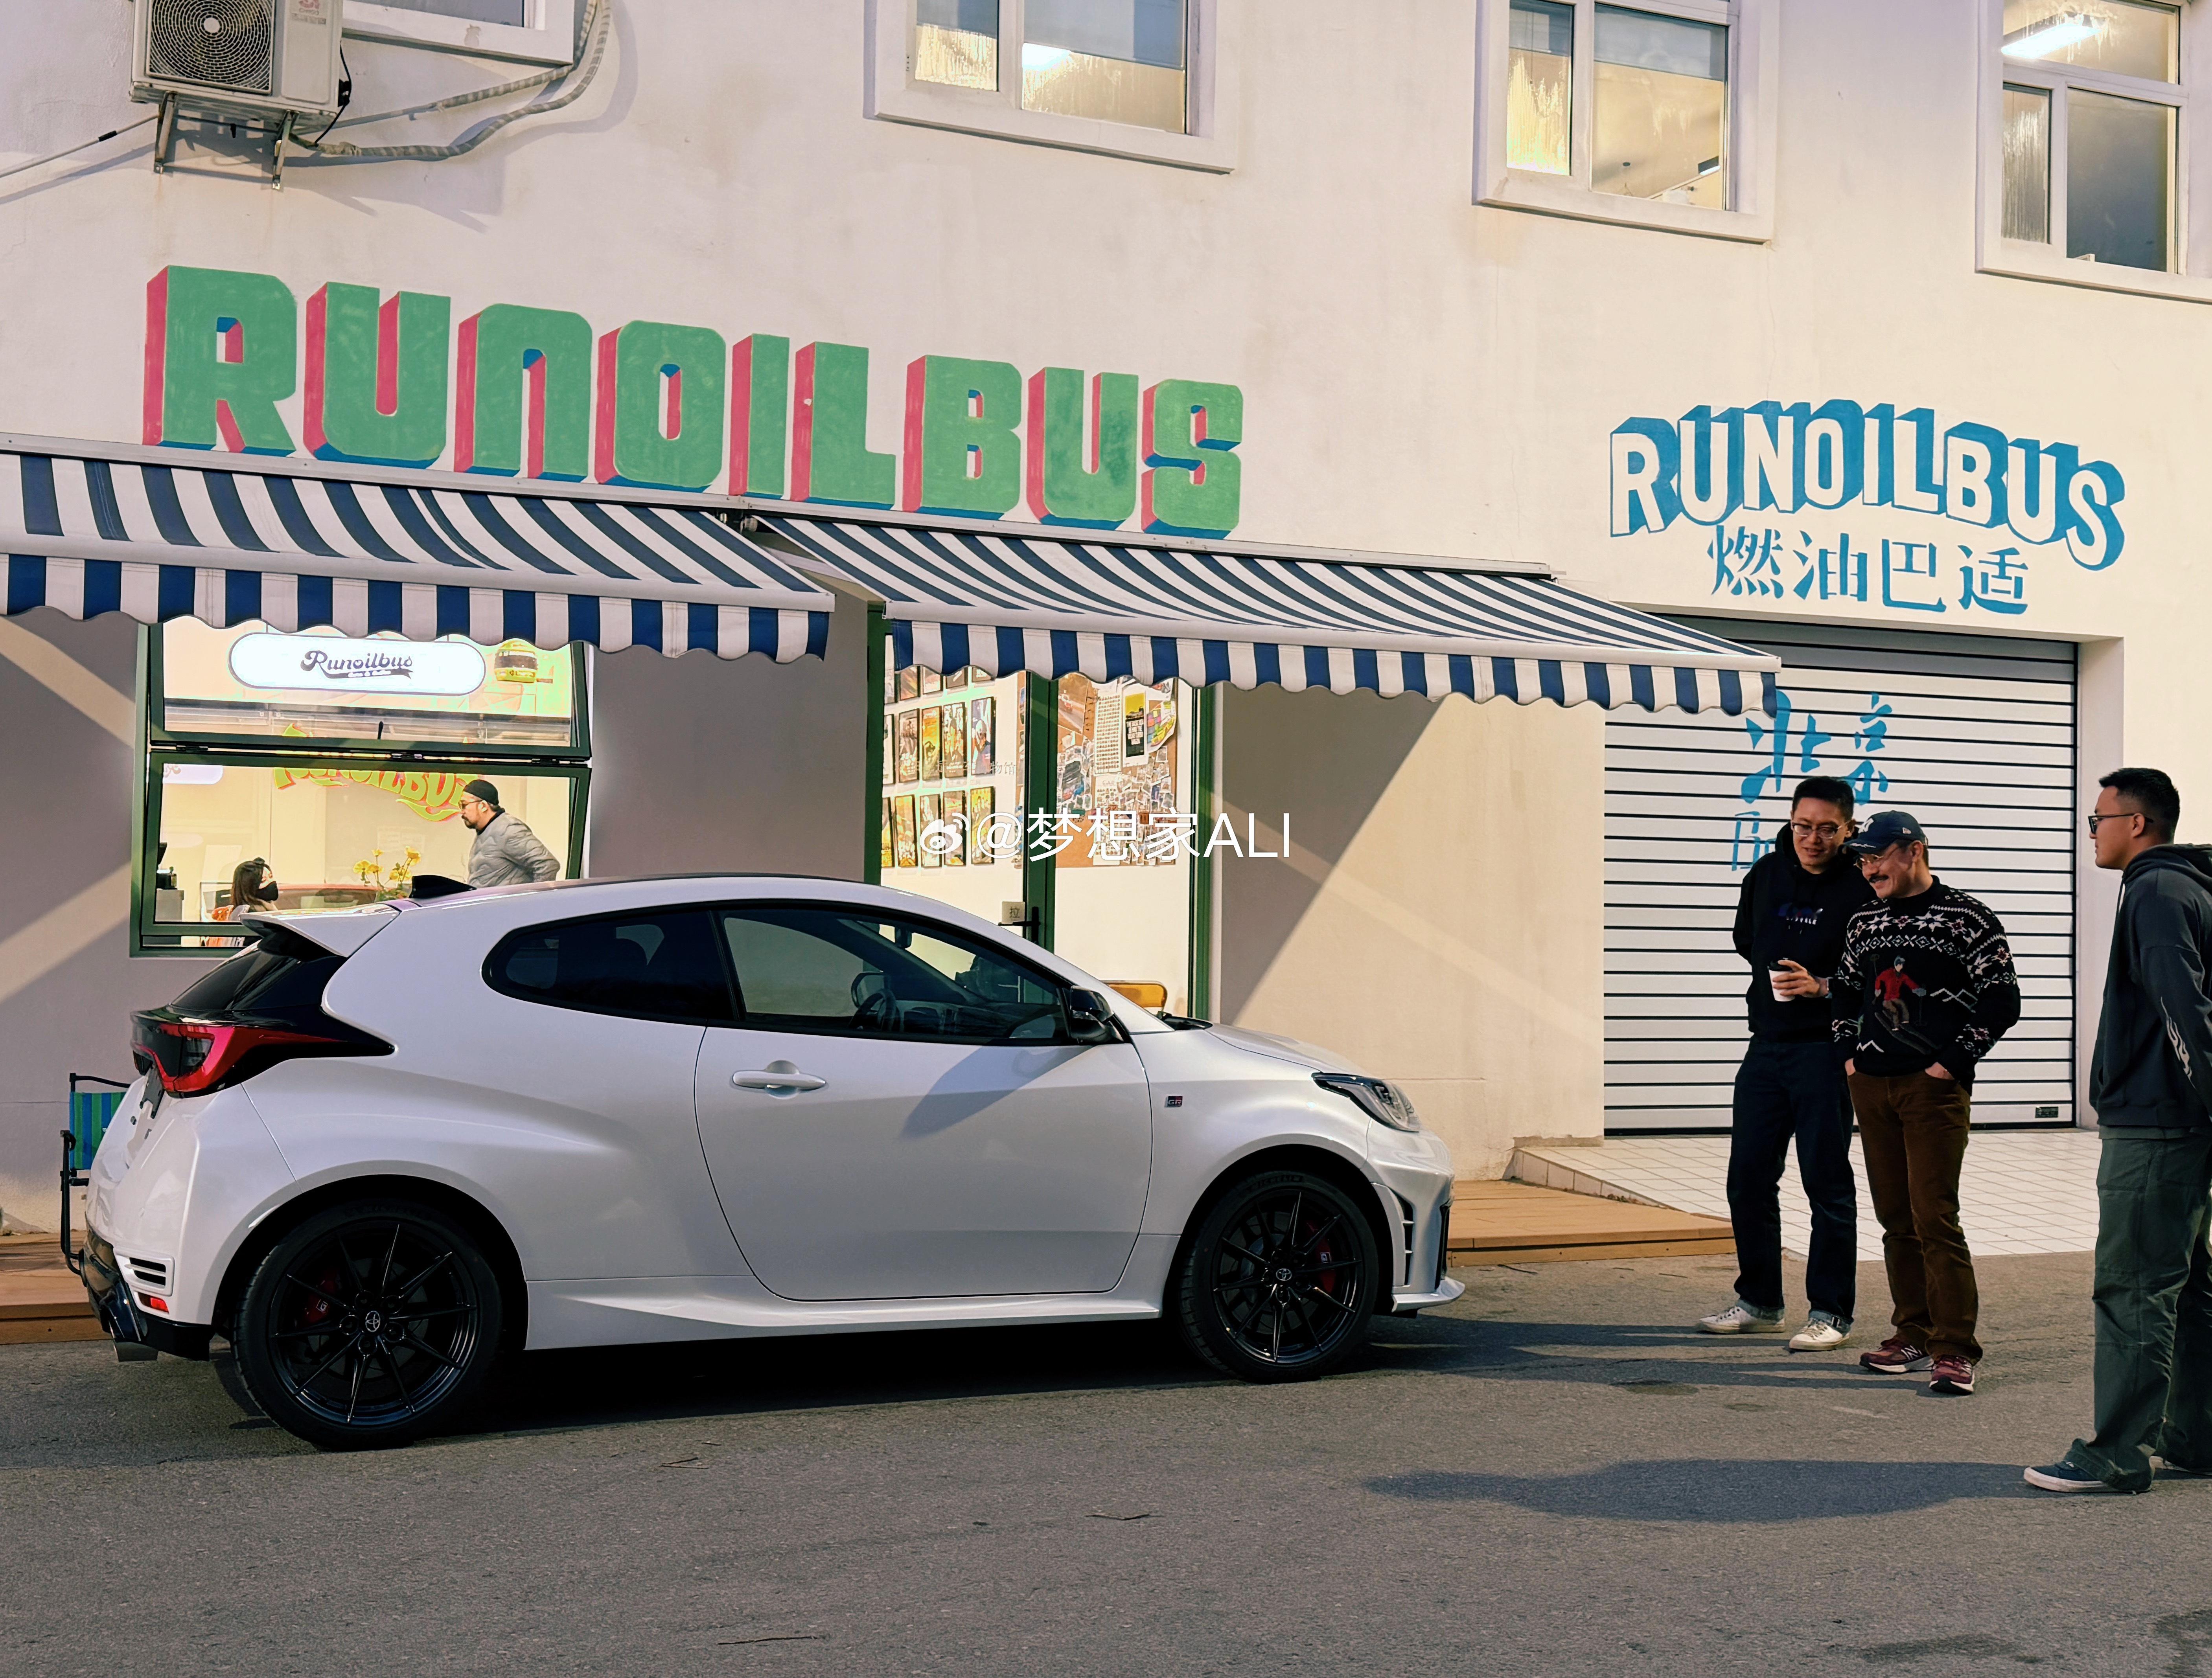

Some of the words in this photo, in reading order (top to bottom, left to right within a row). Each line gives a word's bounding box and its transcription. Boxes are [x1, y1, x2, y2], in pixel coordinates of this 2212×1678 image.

[143, 265, 1243, 539] RUNOILBUS
[1610, 399, 2125, 571] RUNOILBUS
[1707, 525, 2029, 615] 燃油巴适
[300, 650, 413, 679] Runoilbus
[1741, 689, 1892, 805] 北京
[1009, 906, 1020, 918] 拉
